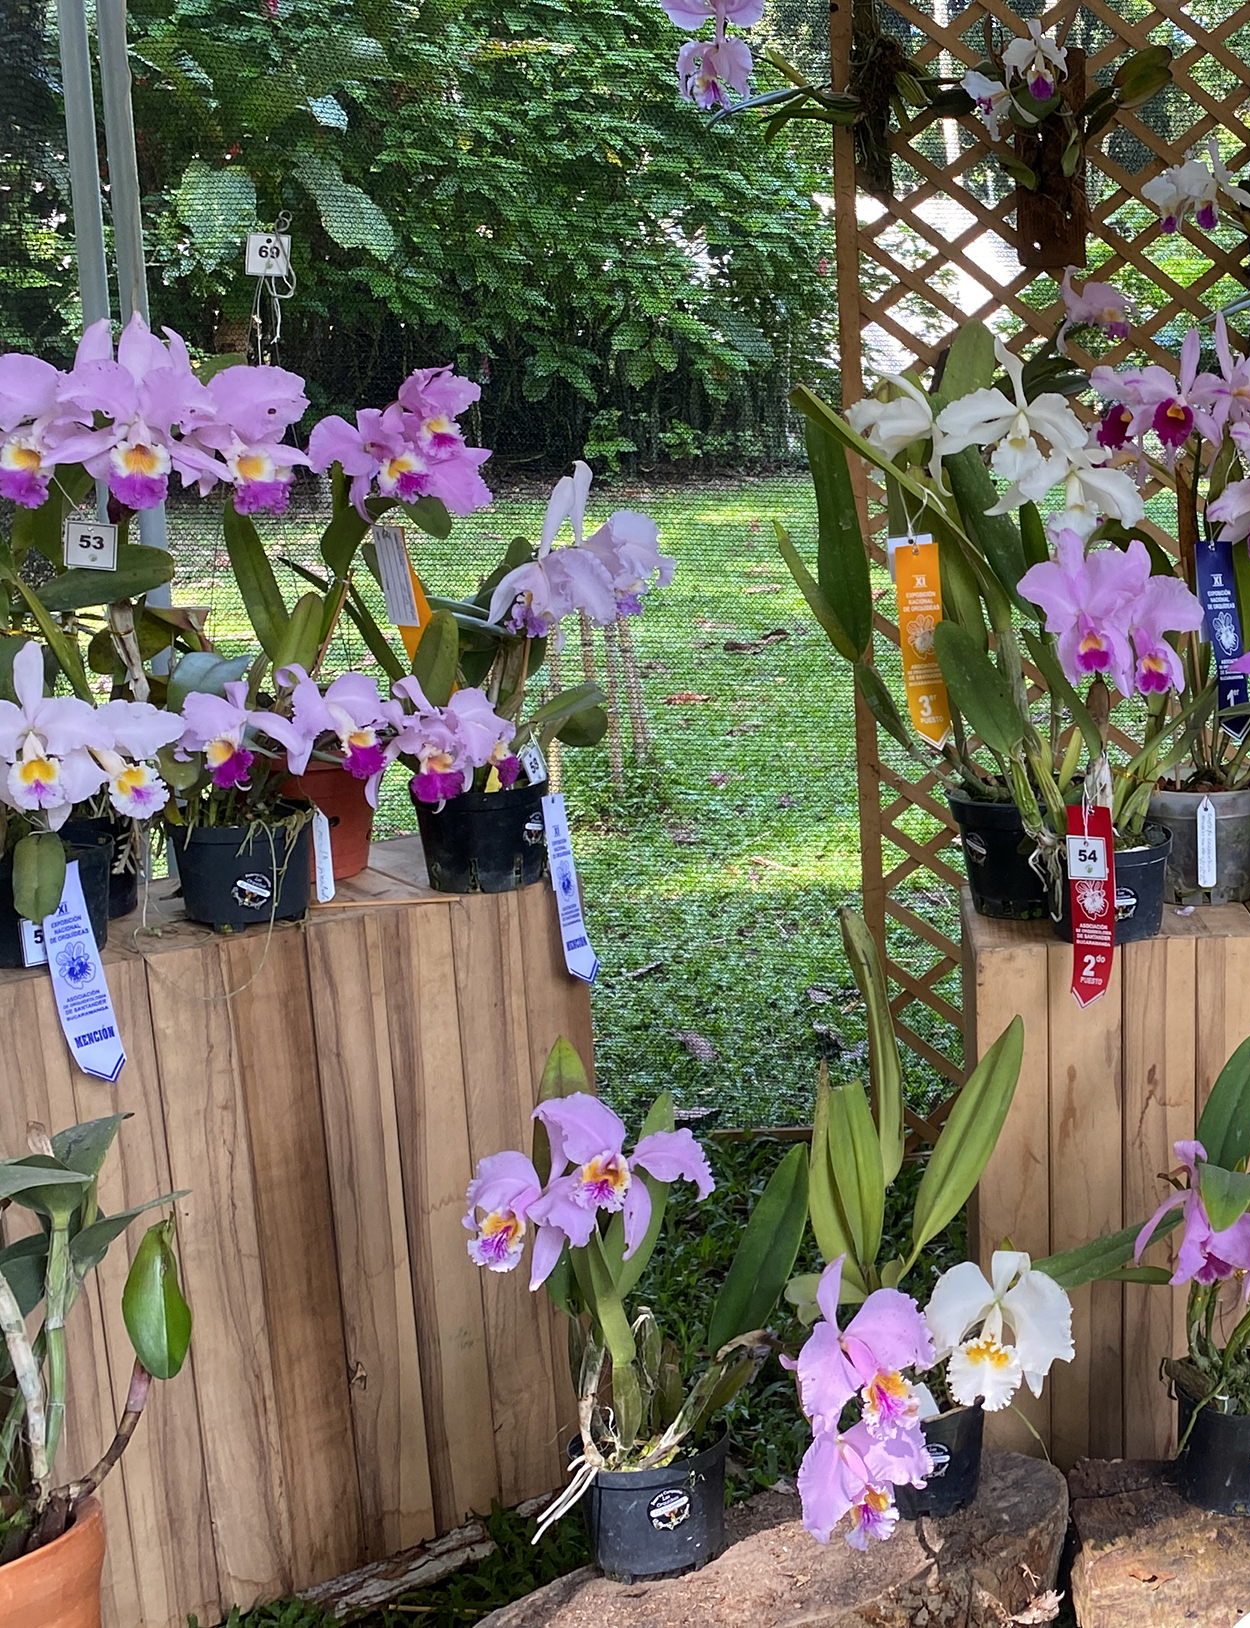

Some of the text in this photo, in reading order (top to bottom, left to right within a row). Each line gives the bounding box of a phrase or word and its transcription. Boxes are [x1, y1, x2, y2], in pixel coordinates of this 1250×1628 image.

[259, 246, 280, 259] 69
[79, 534, 105, 550] 53
[915, 576, 926, 587] XI
[1213, 576, 1223, 586] XI
[920, 716, 944, 724] PUESTO
[1078, 849, 1098, 863] 54
[58, 904, 68, 914] XI
[51, 915, 82, 929] EXPOSICIÓN
[54, 923, 81, 935] NACIONAL
[50, 936, 57, 944] DE
[1080, 976, 1103, 985] PUESTO
[67, 989, 100, 1003] ASOCIACIÓN
[74, 999, 107, 1013] SANTANDER
[74, 1024, 115, 1049] MENCIÓN
